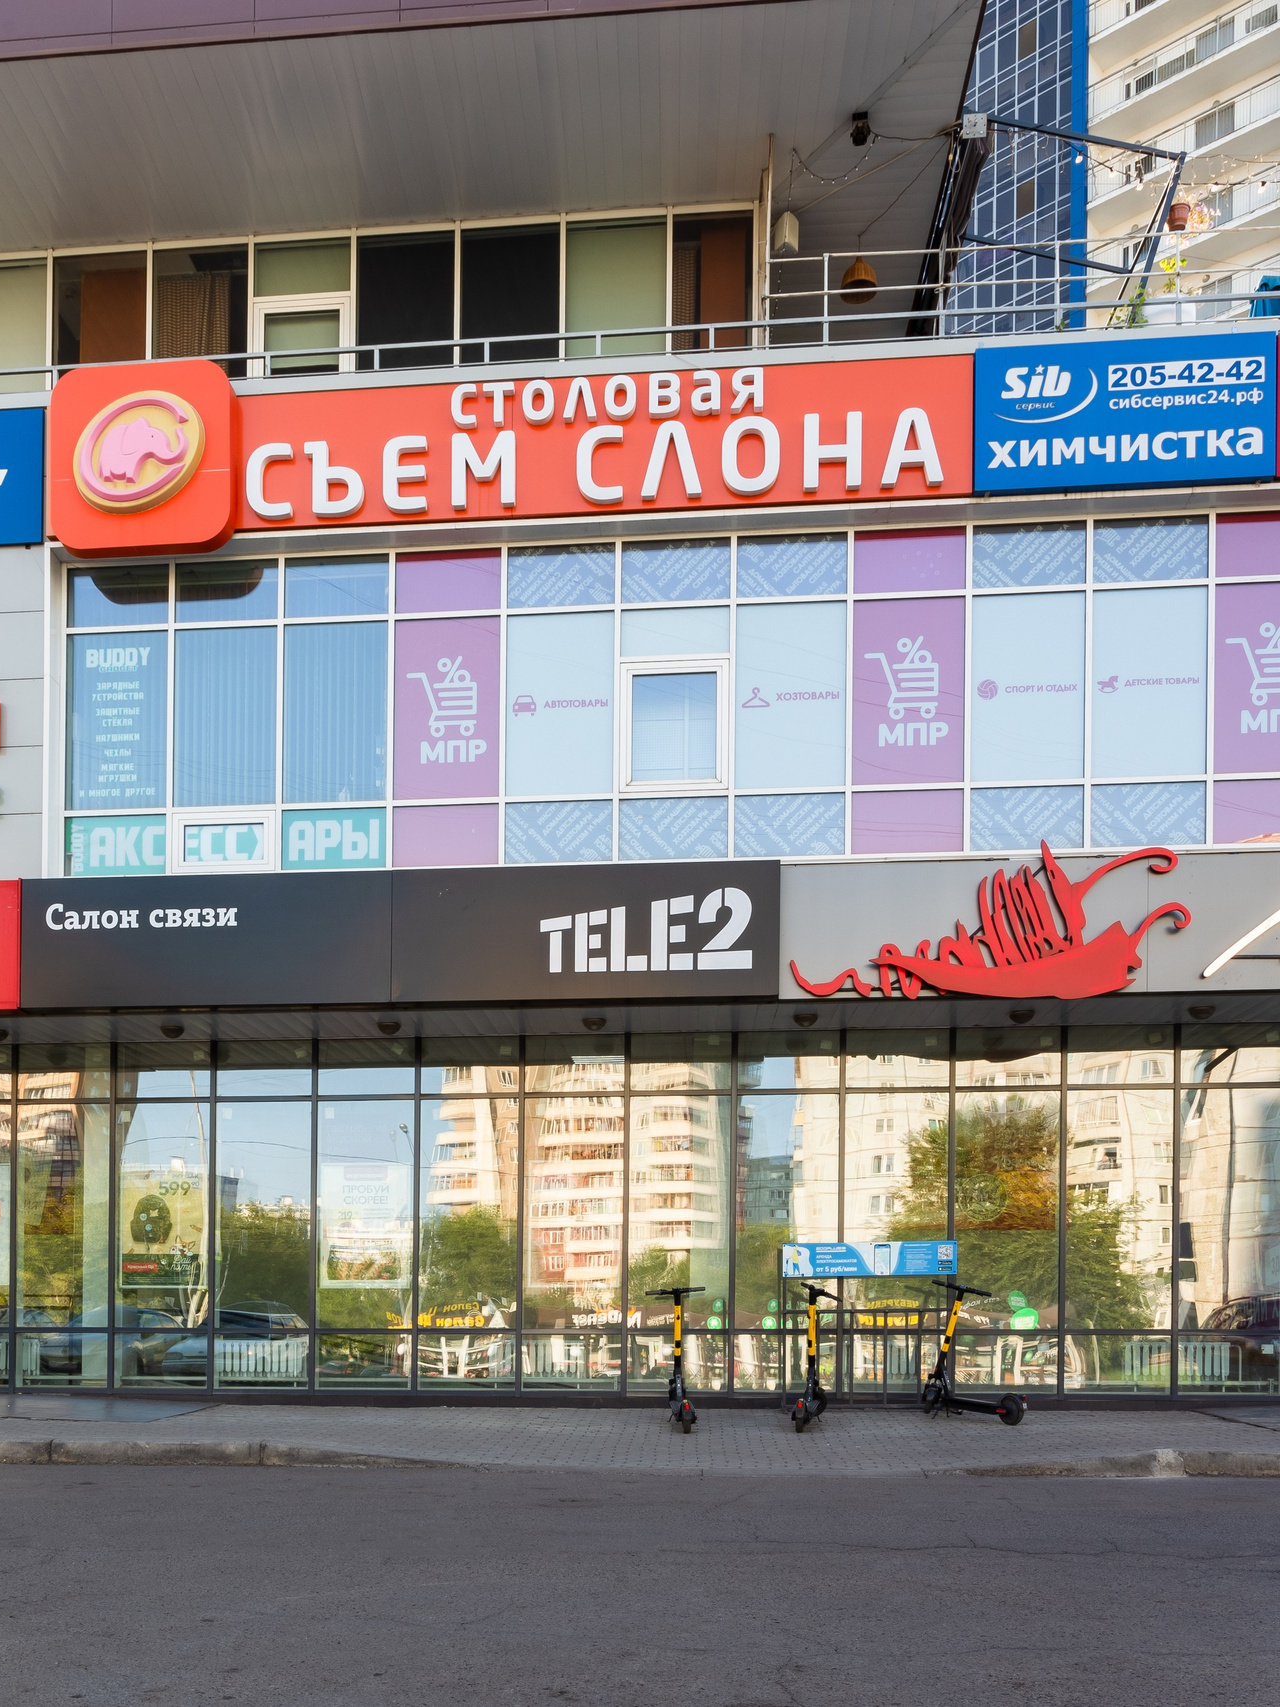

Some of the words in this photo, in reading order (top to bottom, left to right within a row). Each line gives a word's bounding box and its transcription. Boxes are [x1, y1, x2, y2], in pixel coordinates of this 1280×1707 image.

[1110, 359, 1263, 389] 205-42-42
[1108, 386, 1264, 410] сибсервис24.рф
[245, 429, 517, 520] СЪЕМ
[576, 406, 945, 504] СЛОНА
[85, 647, 151, 668] BUDDY
[96, 681, 140, 691] ЗАРЯДНЫЕ
[1004, 684, 1034, 695] СПОРТ
[1036, 684, 1043, 693] И
[1044, 682, 1078, 694] ОТДЫХ
[1124, 677, 1163, 688] ДЕТСКИЕ
[1164, 676, 1200, 686] ТОВАРЫ
[91, 691, 144, 701] УСТРОЙСТВА
[775, 689, 841, 702] ХОЗТОВАРЫ
[543, 698, 609, 710] АВТОТОВАРЫ
[95, 707, 141, 717] ЗАЩИТНЫЕ
[95, 733, 141, 742] НАУШНИКИ
[878, 721, 950, 748] МПР
[104, 748, 132, 757] ЧЕХЛЫ
[419, 738, 488, 765] МПР
[101, 763, 134, 771] МЯГКИЕ
[98, 774, 138, 782] ИГРУШКИ
[89, 789, 121, 797] МНОГОЕ
[125, 787, 156, 797] ДРУГОЕ
[45, 903, 139, 930] Салон
[149, 906, 238, 929] связи
[540, 887, 755, 973] TELE2
[159, 1181, 191, 1195] 599
